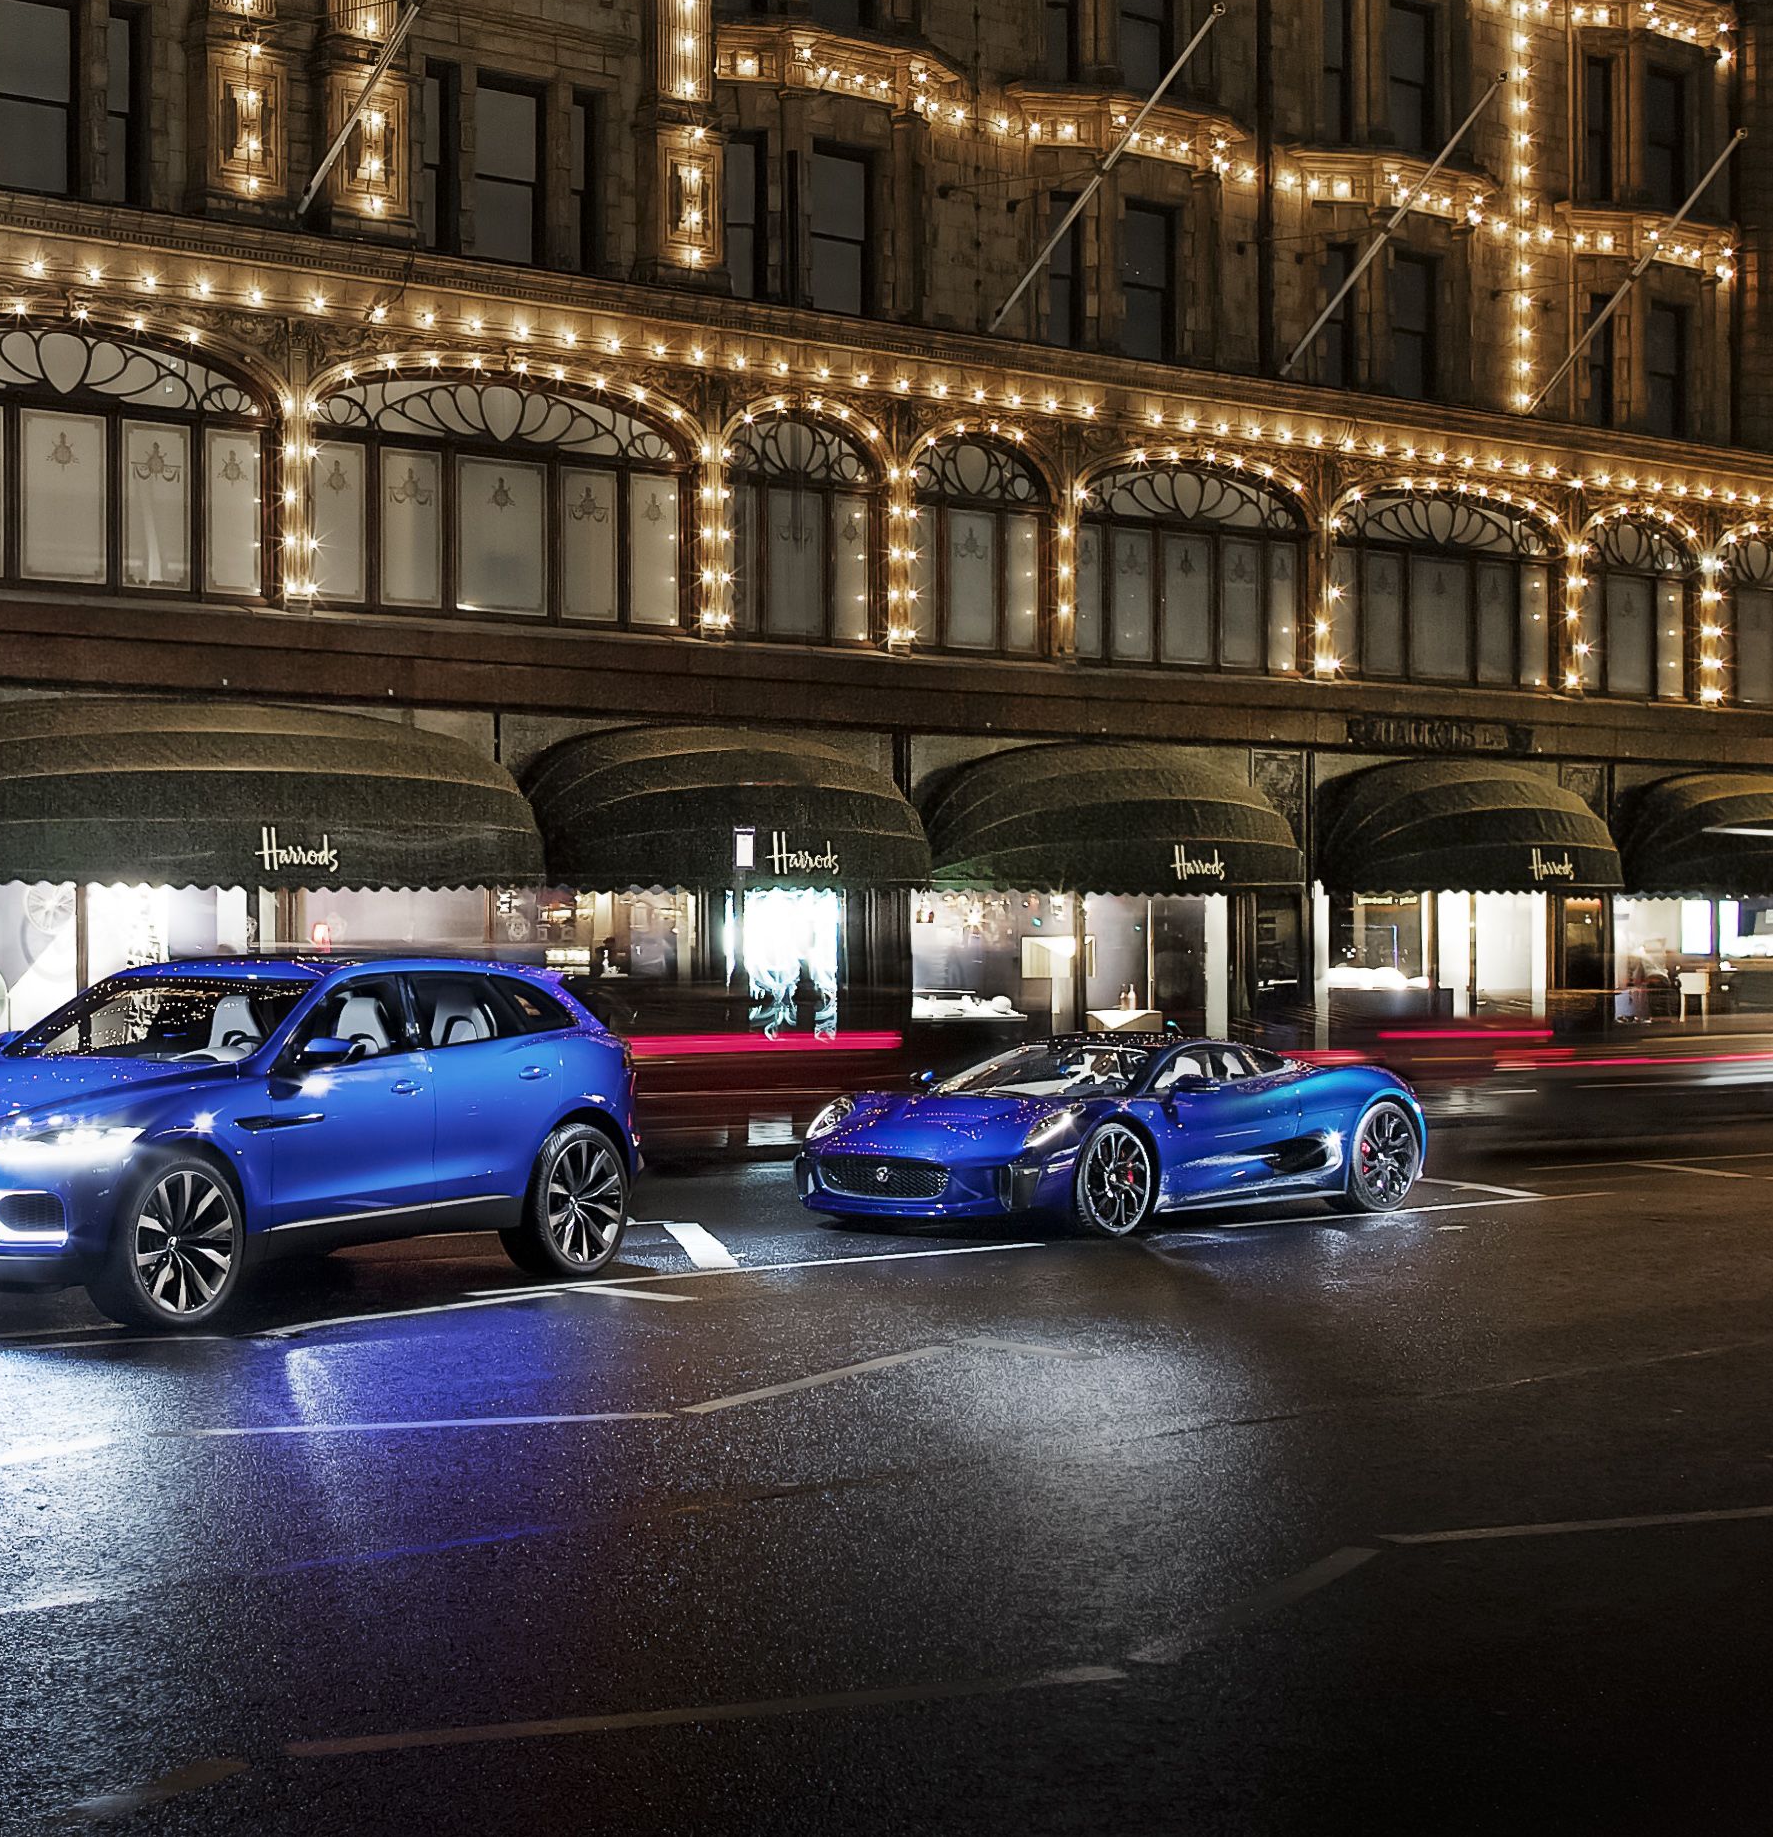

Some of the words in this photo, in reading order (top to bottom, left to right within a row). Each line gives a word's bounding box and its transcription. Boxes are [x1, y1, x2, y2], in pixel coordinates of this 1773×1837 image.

[254, 826, 339, 873] Harrods
[764, 830, 840, 875] Harrods
[1169, 844, 1226, 881] Harrods
